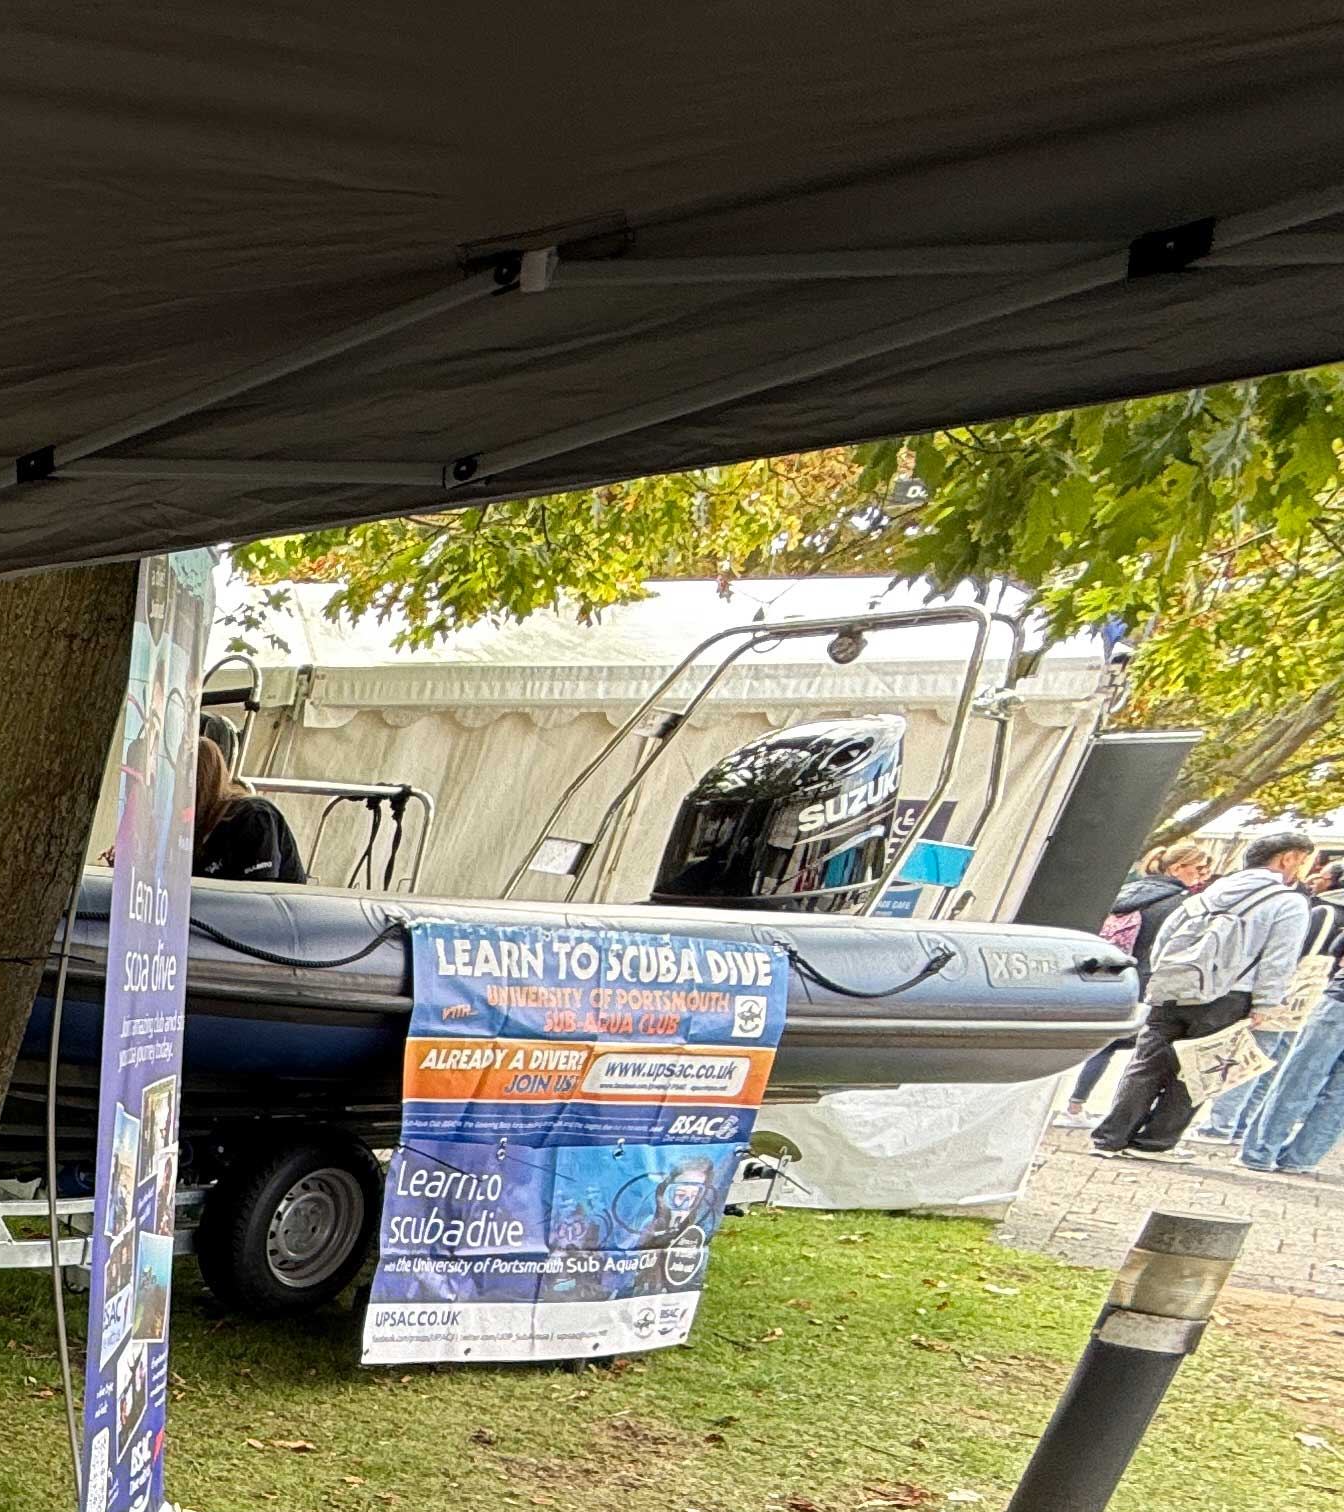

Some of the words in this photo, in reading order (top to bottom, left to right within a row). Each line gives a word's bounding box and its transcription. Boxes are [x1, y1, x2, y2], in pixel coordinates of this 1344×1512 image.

[151, 940, 177, 992] dive
[435, 938, 544, 978] LEARN
[552, 942, 599, 981] TO
[604, 942, 703, 985] SCUBA
[706, 951, 772, 986] DIVE
[486, 985, 582, 1010] UNIVERSITY
[591, 988, 612, 1009] OF
[616, 989, 731, 1014] PORTSMOUTH
[543, 1010, 634, 1035] SUB-AQUA
[637, 1013, 681, 1035] CLUB
[419, 1048, 504, 1070] ALREADY
[509, 1048, 528, 1069] A
[529, 1049, 588, 1072] DIVER?
[604, 1060, 737, 1082] www.upsac.co.uk
[504, 1074, 549, 1093] JOIN
[669, 1115, 724, 1136] BSAC
[396, 1161, 478, 1201] Learn
[389, 1208, 463, 1247] scuba
[464, 1210, 524, 1248] dive
[396, 1256, 411, 1272] the
[413, 1257, 472, 1275] University
[473, 1256, 490, 1274] of
[490, 1256, 563, 1274] Portsmouth
[566, 1257, 600, 1273] Sub
[603, 1257, 639, 1275] Aqua
[639, 1255, 658, 1271] Club
